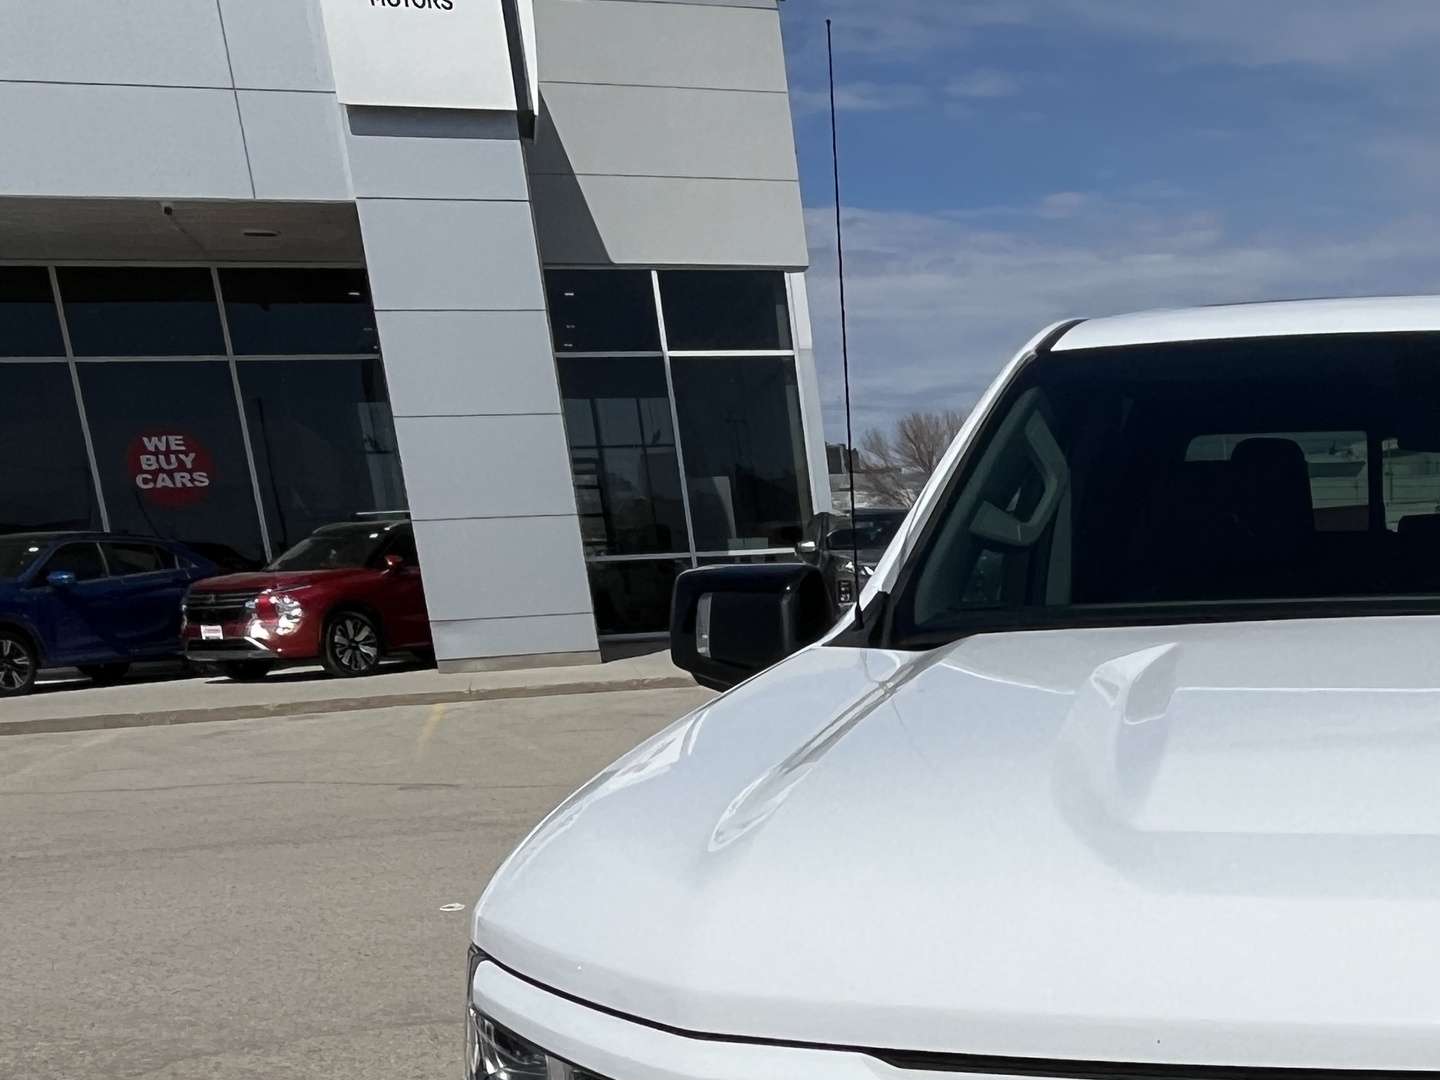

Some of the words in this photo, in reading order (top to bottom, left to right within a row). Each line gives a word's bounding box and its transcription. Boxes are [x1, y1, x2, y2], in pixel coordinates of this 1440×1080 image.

[142, 435, 186, 452] WE
[140, 452, 196, 470] BUY
[136, 471, 210, 489] CARS
